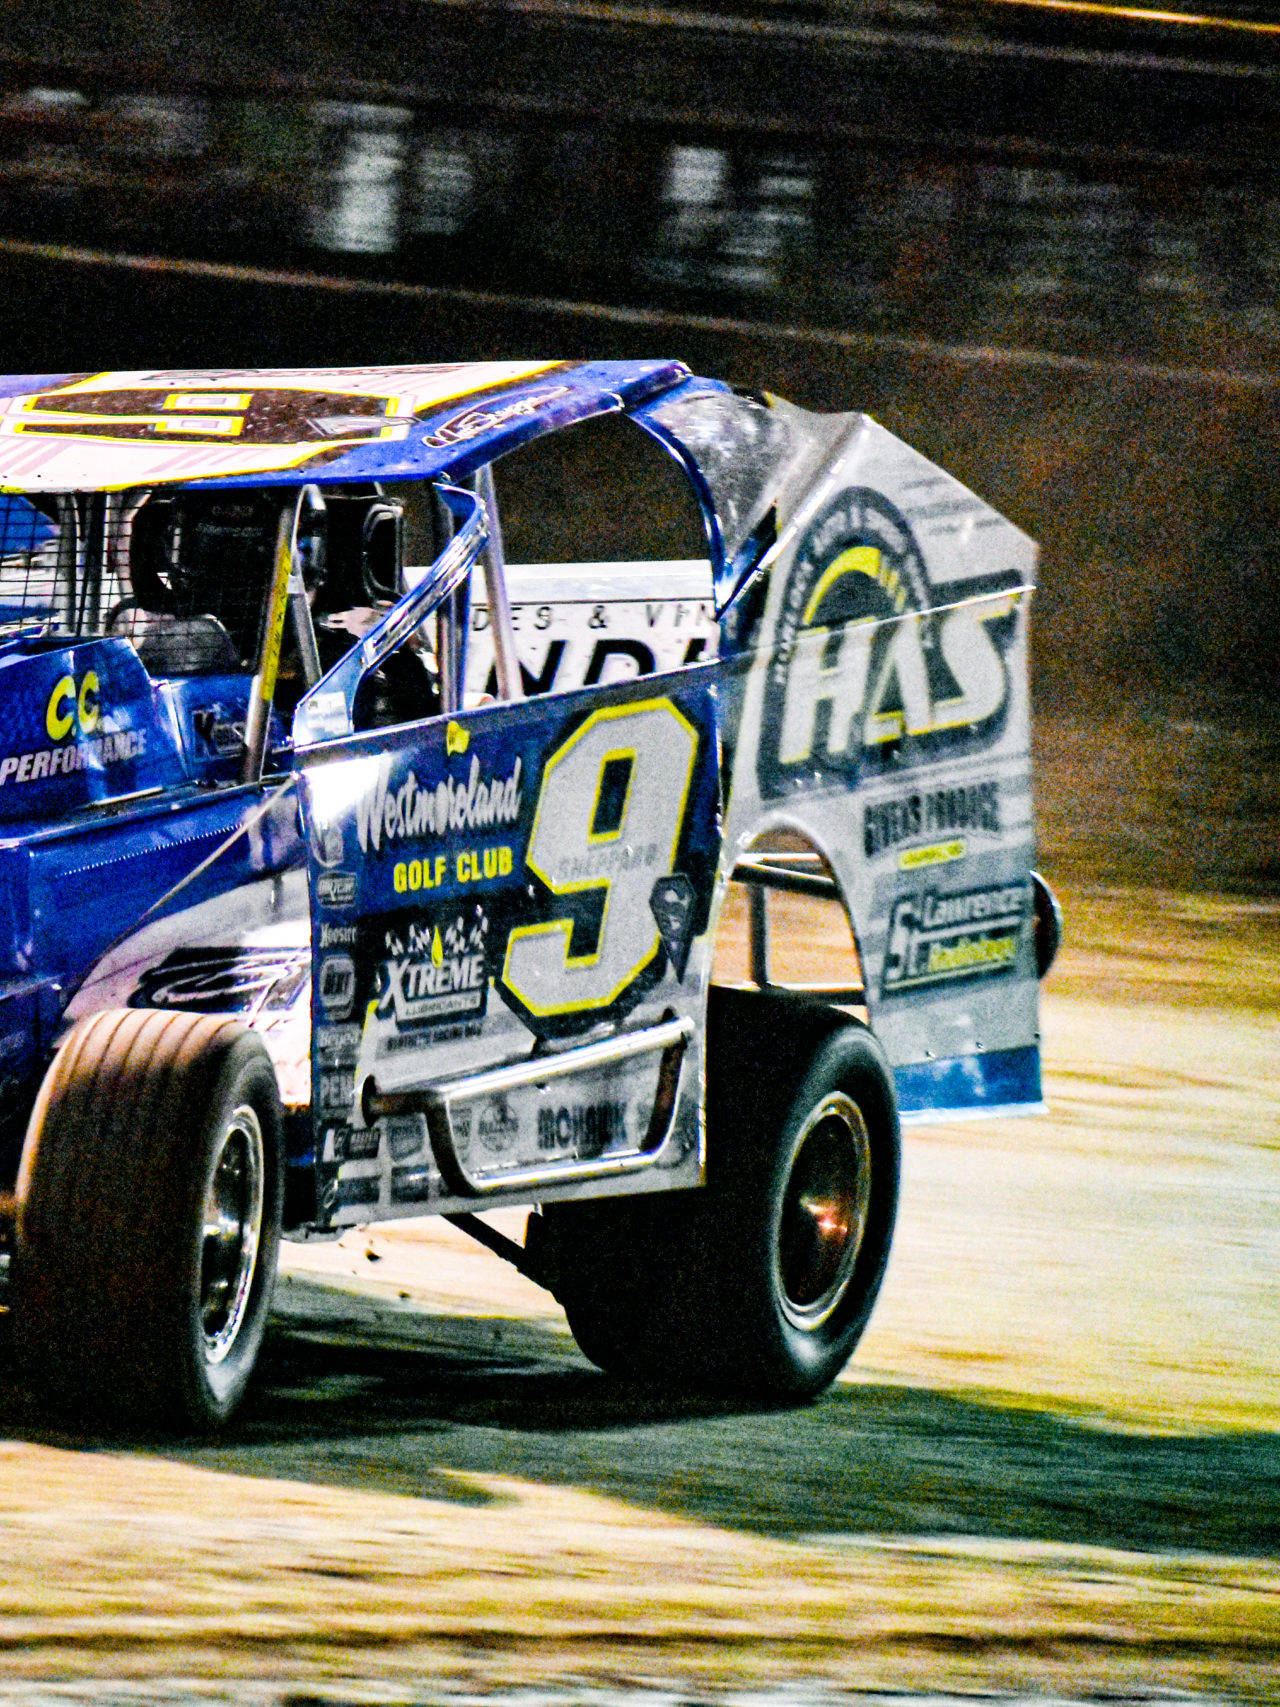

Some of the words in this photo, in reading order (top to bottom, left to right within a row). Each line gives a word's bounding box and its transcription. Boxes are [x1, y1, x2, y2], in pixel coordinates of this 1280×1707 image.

[588, 605, 608, 629] &
[779, 597, 1017, 764] HAS
[393, 855, 447, 893] GOLF
[457, 846, 513, 883] CLUB
[502, 697, 699, 1017] 9
